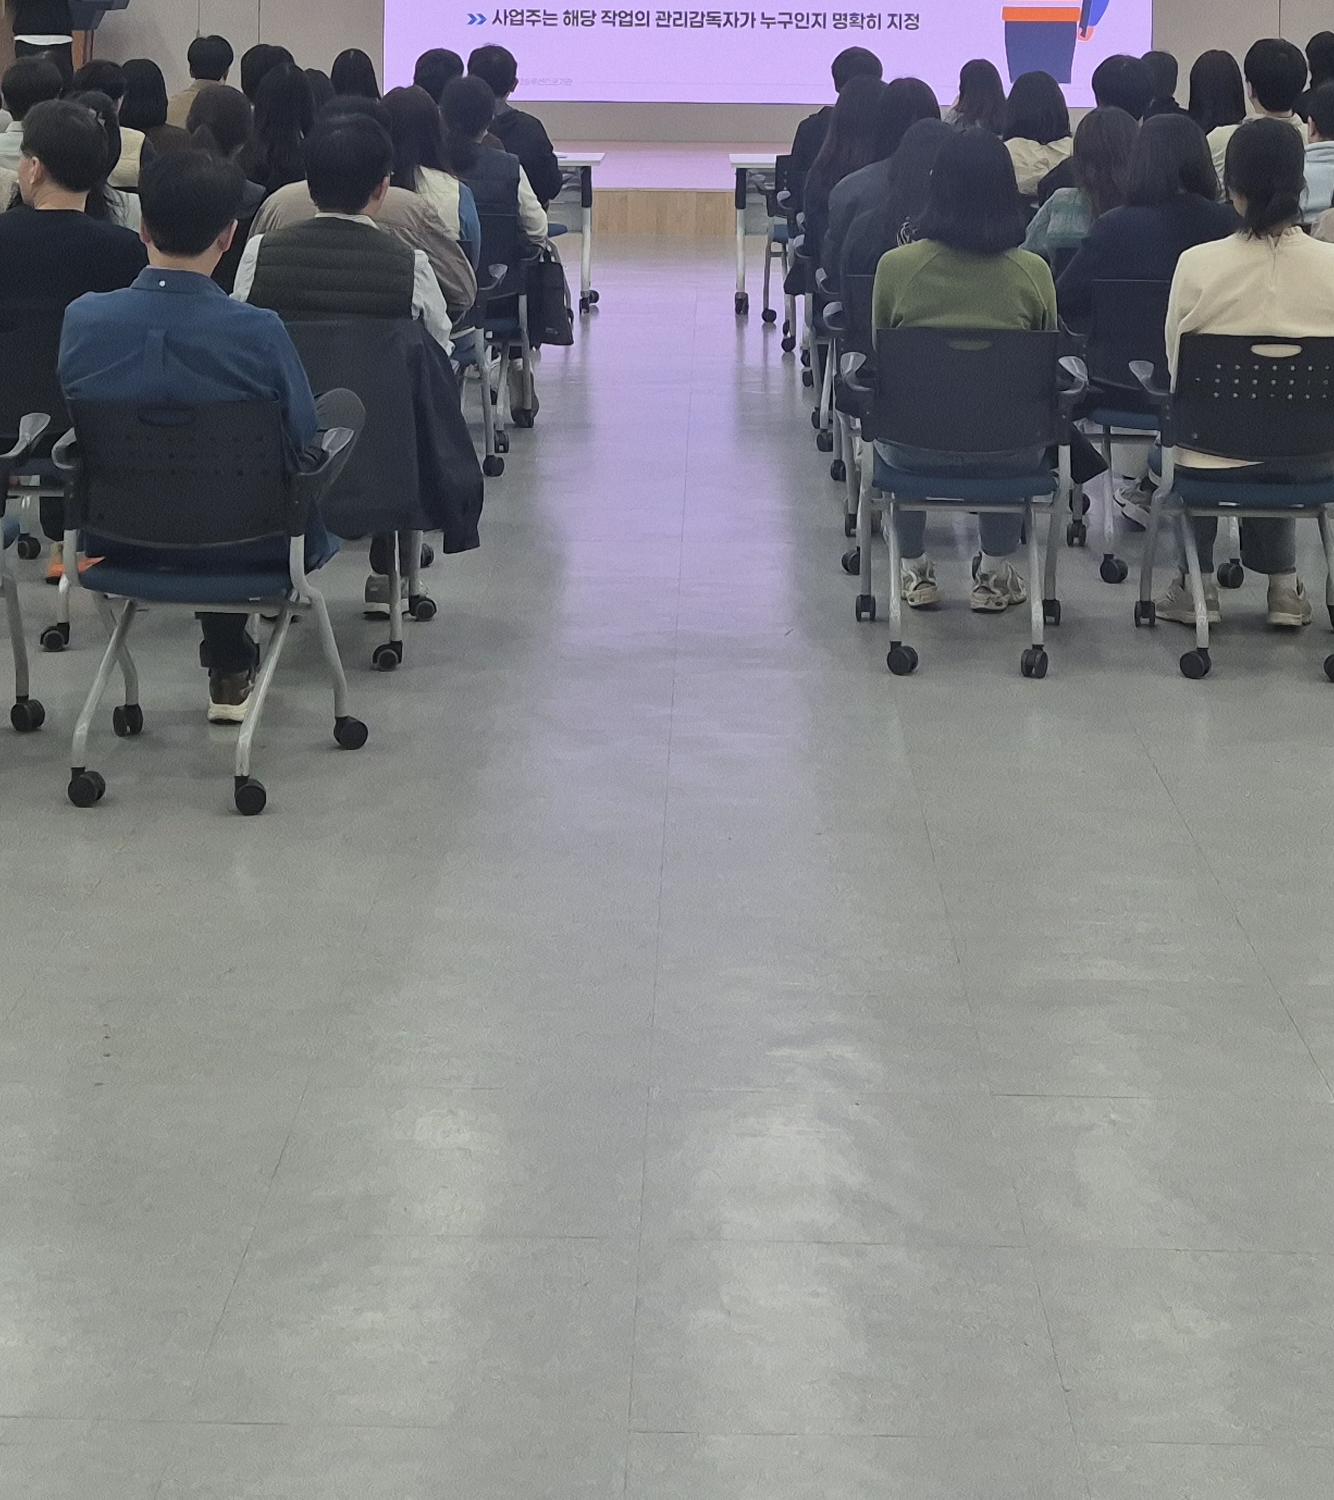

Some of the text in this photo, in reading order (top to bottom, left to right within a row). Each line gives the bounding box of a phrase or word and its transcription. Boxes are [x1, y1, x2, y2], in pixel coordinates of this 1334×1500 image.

[491, 9, 921, 31] 사업주는 해당 작업의 관리감독자가 누구인지 명확히 지정
